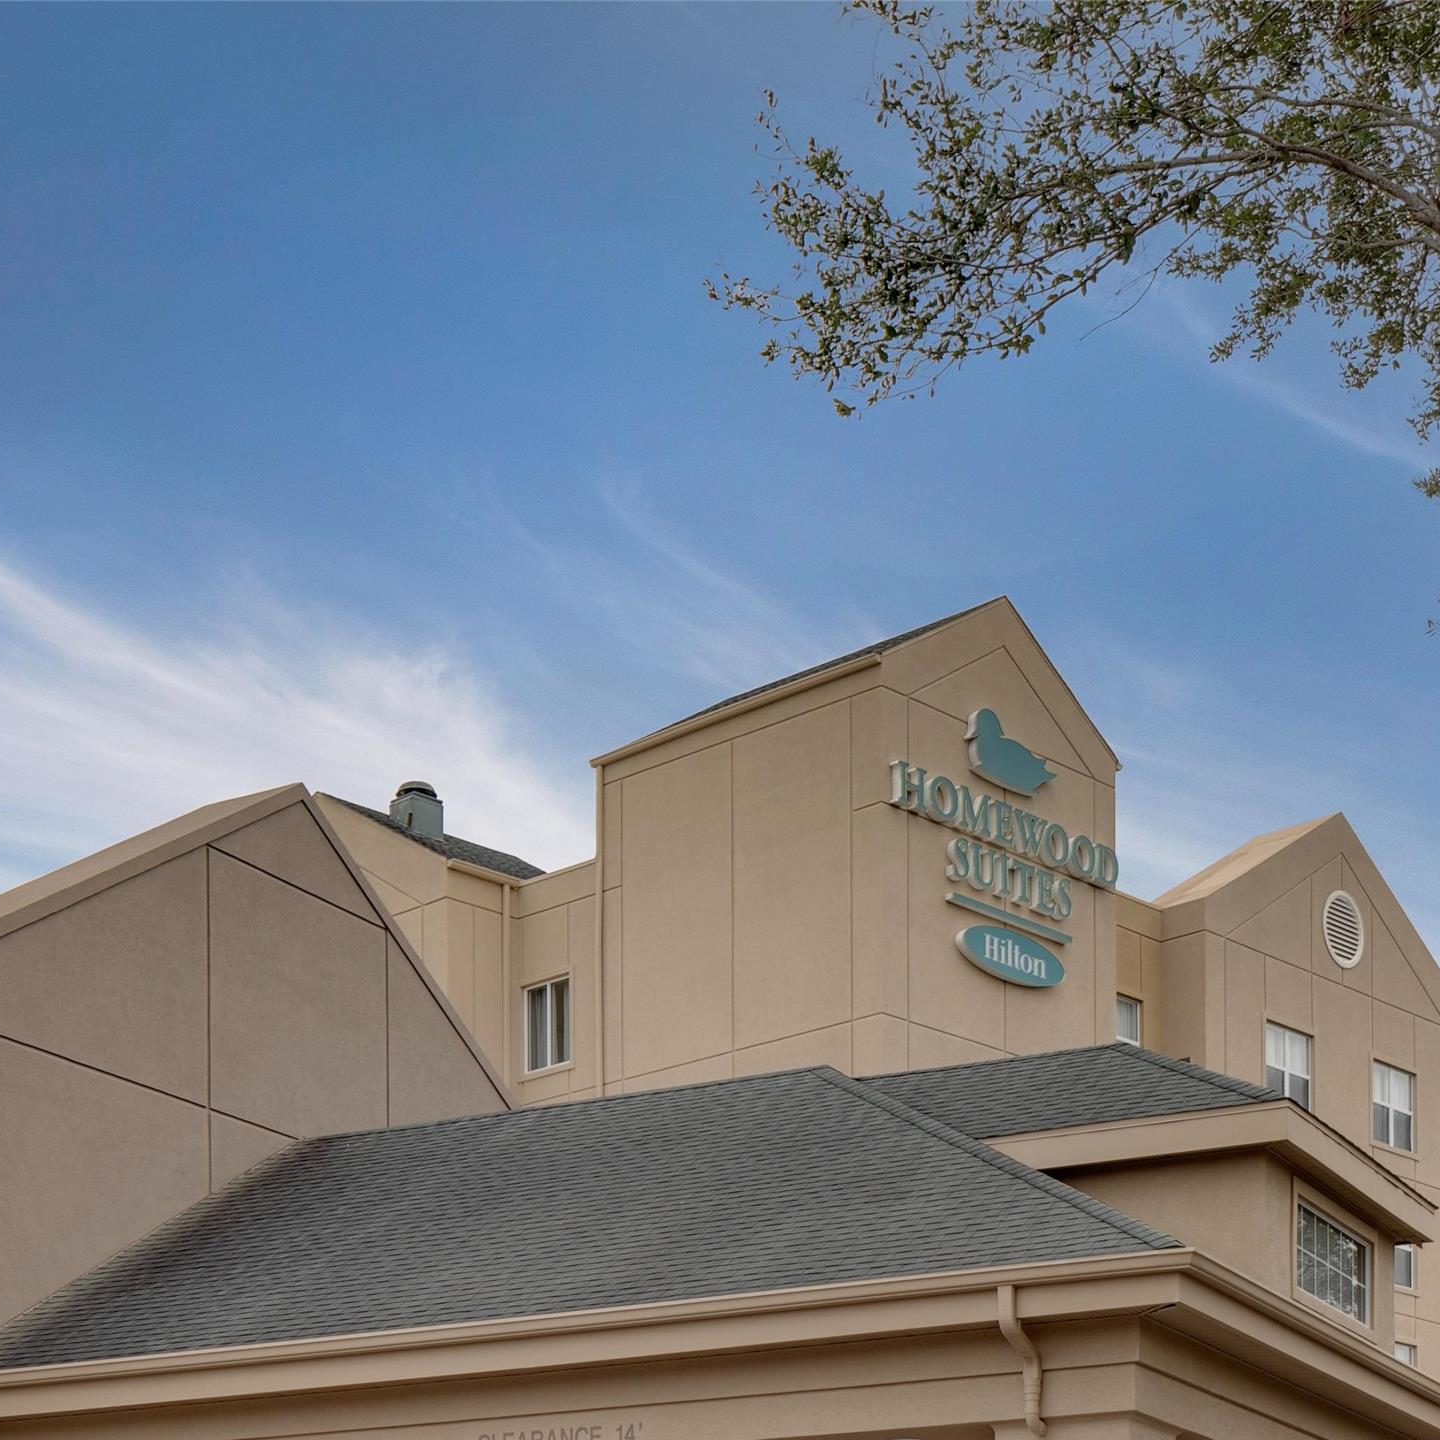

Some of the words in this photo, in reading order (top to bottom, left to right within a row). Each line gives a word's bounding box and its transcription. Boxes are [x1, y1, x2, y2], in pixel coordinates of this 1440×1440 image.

[889, 760, 1119, 887] HOMEWOOD
[945, 838, 1072, 921] SUITES
[983, 932, 1047, 979] Hilton
